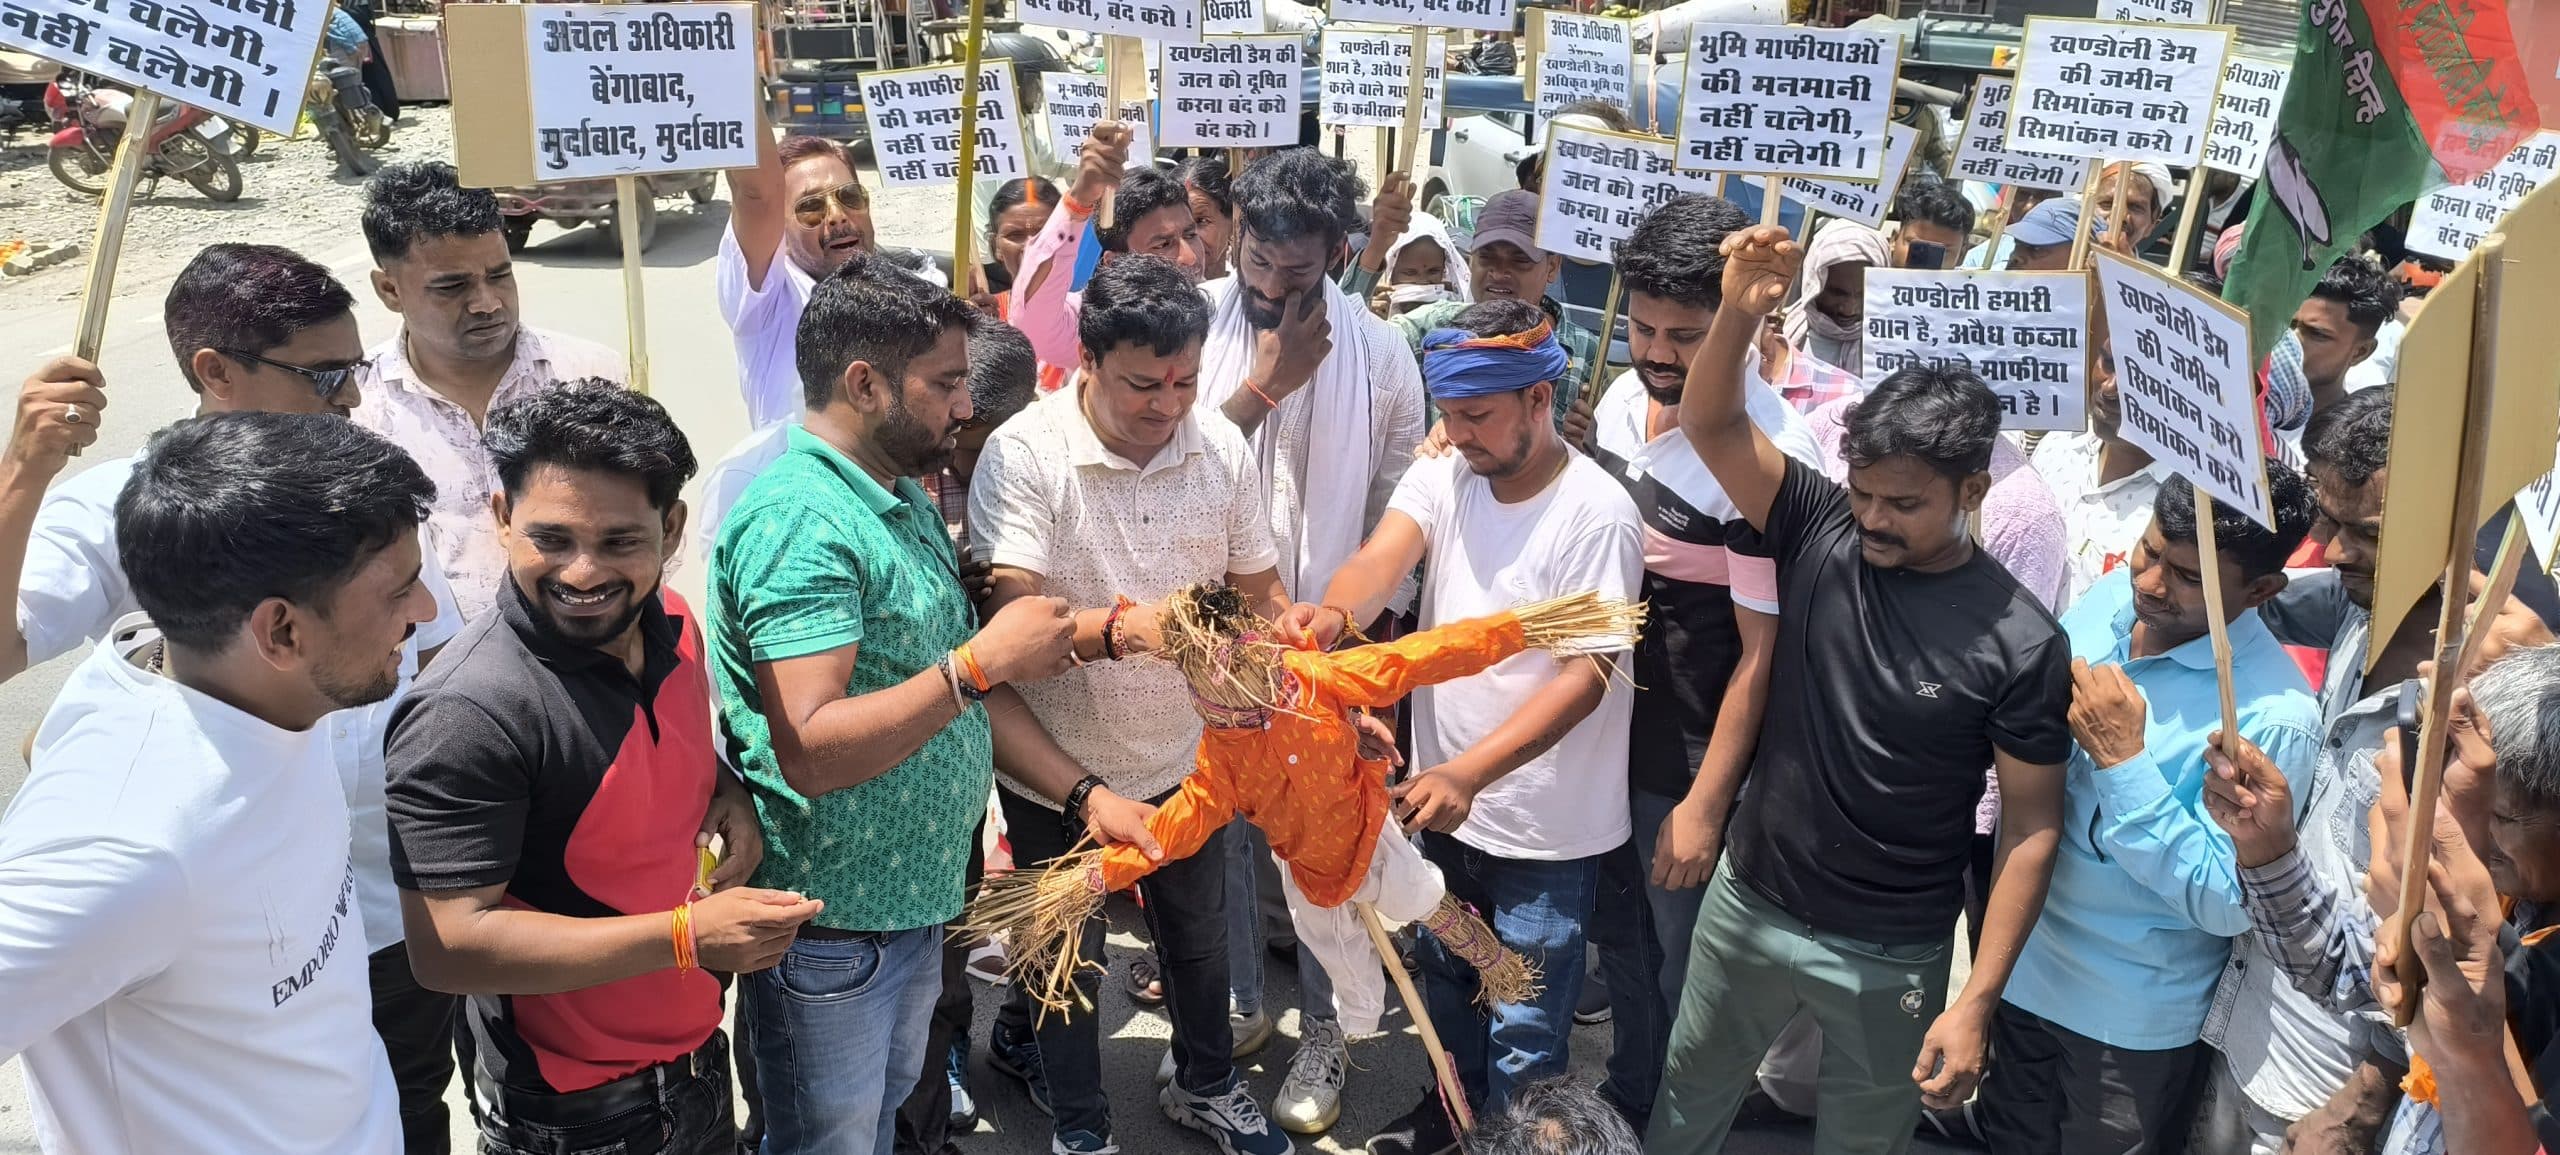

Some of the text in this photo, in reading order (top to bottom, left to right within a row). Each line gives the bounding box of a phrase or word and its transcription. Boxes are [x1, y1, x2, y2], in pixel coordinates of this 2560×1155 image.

[1140, 5, 1176, 27] करो
[1551, 16, 1622, 44] अंचल अधिकारी
[129, 0, 278, 76] चलेगी,
[542, 10, 735, 52] अंचल अधिकारी
[1, 2, 101, 56] नहीं
[108, 36, 245, 107] चलेगी
[1169, 43, 1296, 64] खण्डोली डैम की
[1339, 39, 1389, 57] खण्डोली
[1700, 31, 1886, 65] भुमि माफीयाओं
[2050, 34, 2197, 64] खण्डोली डैम
[1325, 61, 1349, 75] शान
[1545, 58, 1591, 73] खण्डोली
[2060, 62, 2173, 93] की जमीन
[2223, 63, 2285, 91] फीयाओं
[589, 64, 695, 108] बेंगाबाद,
[868, 69, 1000, 107] भुमि माफीयओं
[1178, 72, 1212, 89] जल
[1218, 70, 1242, 89] को
[1247, 70, 1287, 95] दूषित
[1329, 80, 1355, 96] करने
[1359, 81, 1384, 98] वाले
[1701, 68, 1871, 101] की मनमानी
[877, 100, 1004, 128] की मनमनी
[1088, 103, 1102, 118] की
[1177, 95, 1286, 114] करना बंद करो
[1333, 102, 1348, 115] का
[2032, 88, 2189, 125] सिमांकन करो
[1195, 119, 1220, 138] बंद
[1226, 121, 1257, 138] करो
[1700, 103, 1862, 139] नहीं चलेगी,
[2018, 116, 2118, 148] सिमांकन
[2126, 129, 2172, 153] करो
[2210, 115, 2258, 147] लेगी,
[538, 112, 744, 170] मुर्दाबाद, मुर्दाबाद
[885, 133, 927, 155] नहीं
[1690, 136, 1749, 162] नहीं
[1754, 138, 1841, 168] चलेगी
[2204, 140, 2242, 166] लेगी
[886, 160, 927, 181] नहीं
[1557, 139, 1675, 176] खण्डोली डैम
[2533, 144, 2557, 169] की
[1563, 170, 1600, 193] जल
[1607, 176, 1634, 199] को
[1961, 157, 2003, 176] नहीं
[2004, 163, 2064, 185] चलेगी
[1559, 197, 1608, 224] करना
[1830, 190, 1865, 213] करो
[2431, 193, 2497, 224] करना बंद
[1576, 227, 1602, 251] बंद
[2438, 222, 2460, 248] बंद
[1892, 282, 2052, 313] खण्डोली हमारी
[1868, 315, 2078, 349] शान है, अवैध कब्जा
[2117, 280, 2230, 369] खण्डोली डैम
[1980, 356, 2069, 383] माफीया
[2135, 328, 2223, 406] की जमीन
[2021, 389, 2041, 416] है
[2124, 356, 2244, 463] सिमांकन करो
[2124, 393, 2201, 470] सिमांकन
[2205, 451, 2245, 500] करो
[271, 915, 339, 1008] EMPORIO
